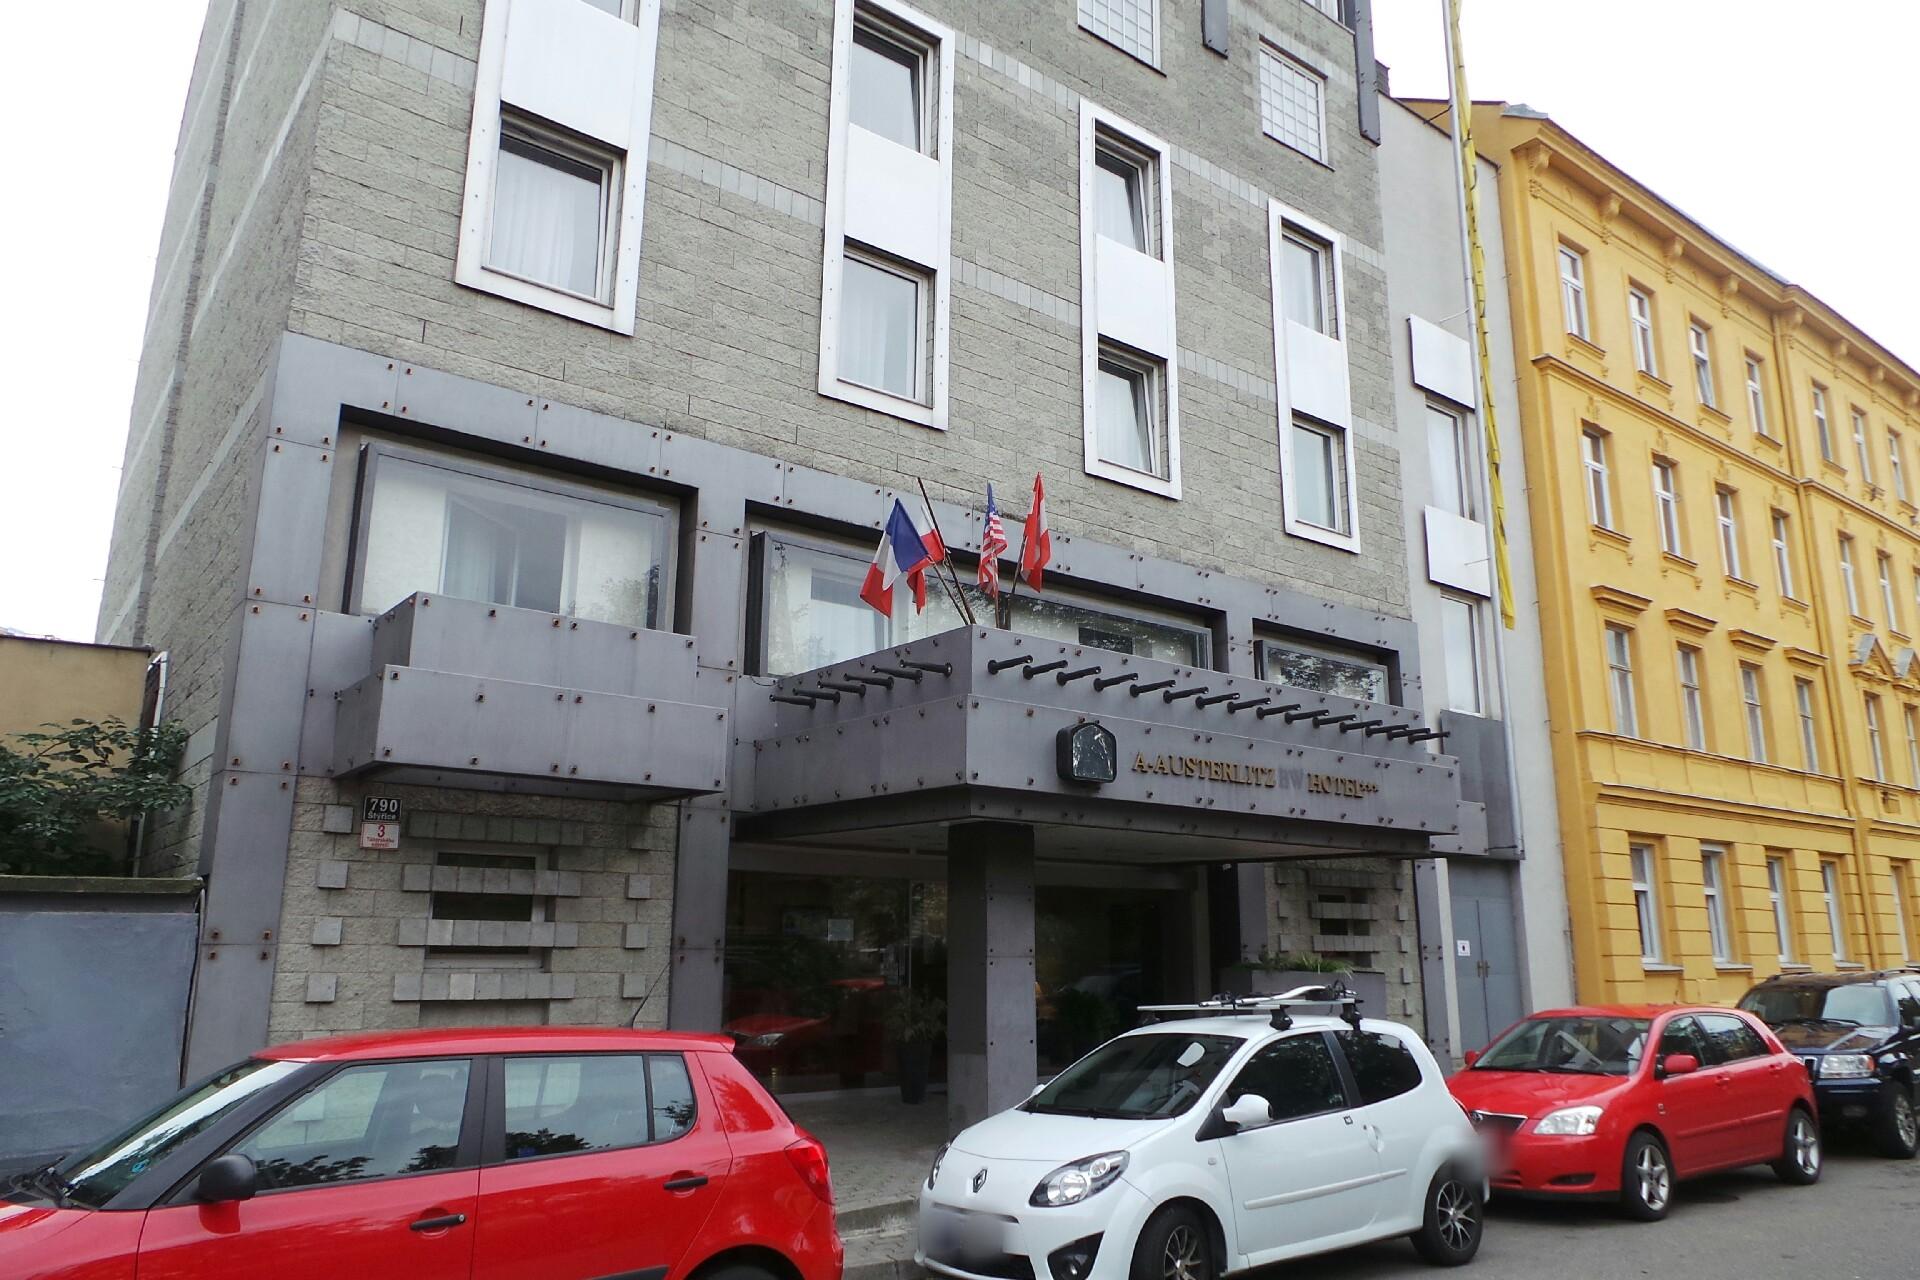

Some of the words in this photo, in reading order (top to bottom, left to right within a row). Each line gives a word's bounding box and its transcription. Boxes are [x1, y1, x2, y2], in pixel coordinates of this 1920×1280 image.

[1132, 751, 1277, 788] A-AUSTERLITZ
[370, 798, 398, 812] 790
[377, 824, 385, 837] 3
